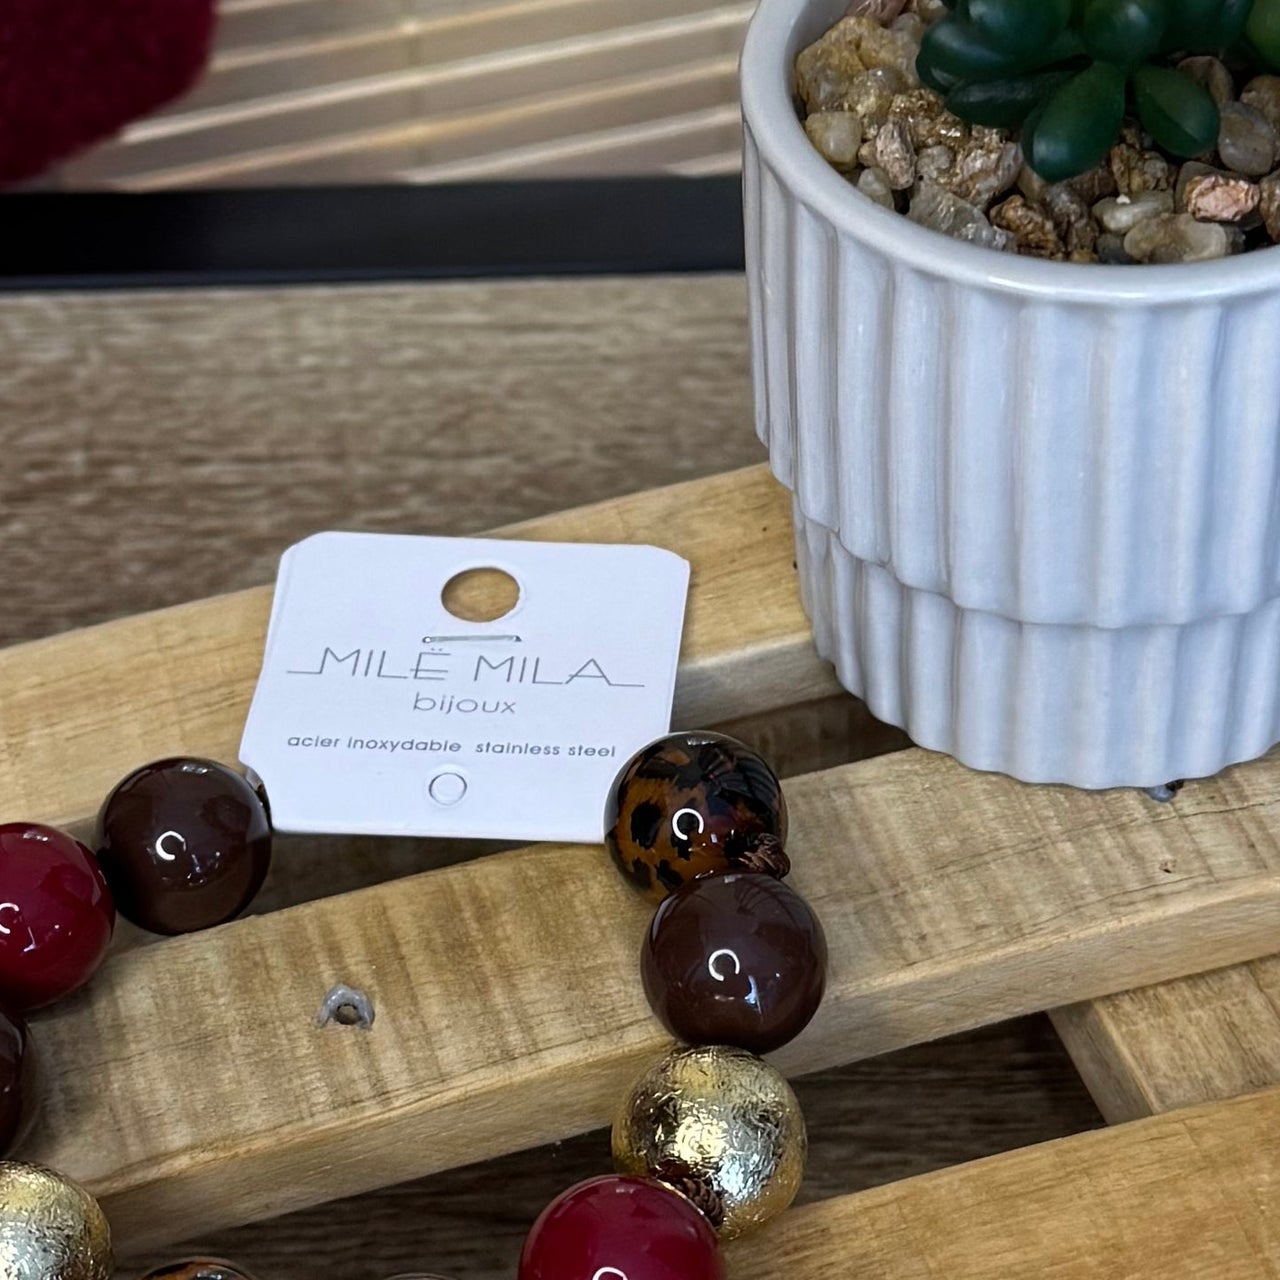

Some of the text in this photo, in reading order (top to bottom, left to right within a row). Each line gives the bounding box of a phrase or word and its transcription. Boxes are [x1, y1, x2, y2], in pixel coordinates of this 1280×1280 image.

[473, 654, 615, 687] MILA
[413, 691, 516, 715] bijoux
[287, 733, 616, 758] acier inoxydable stainless steel
